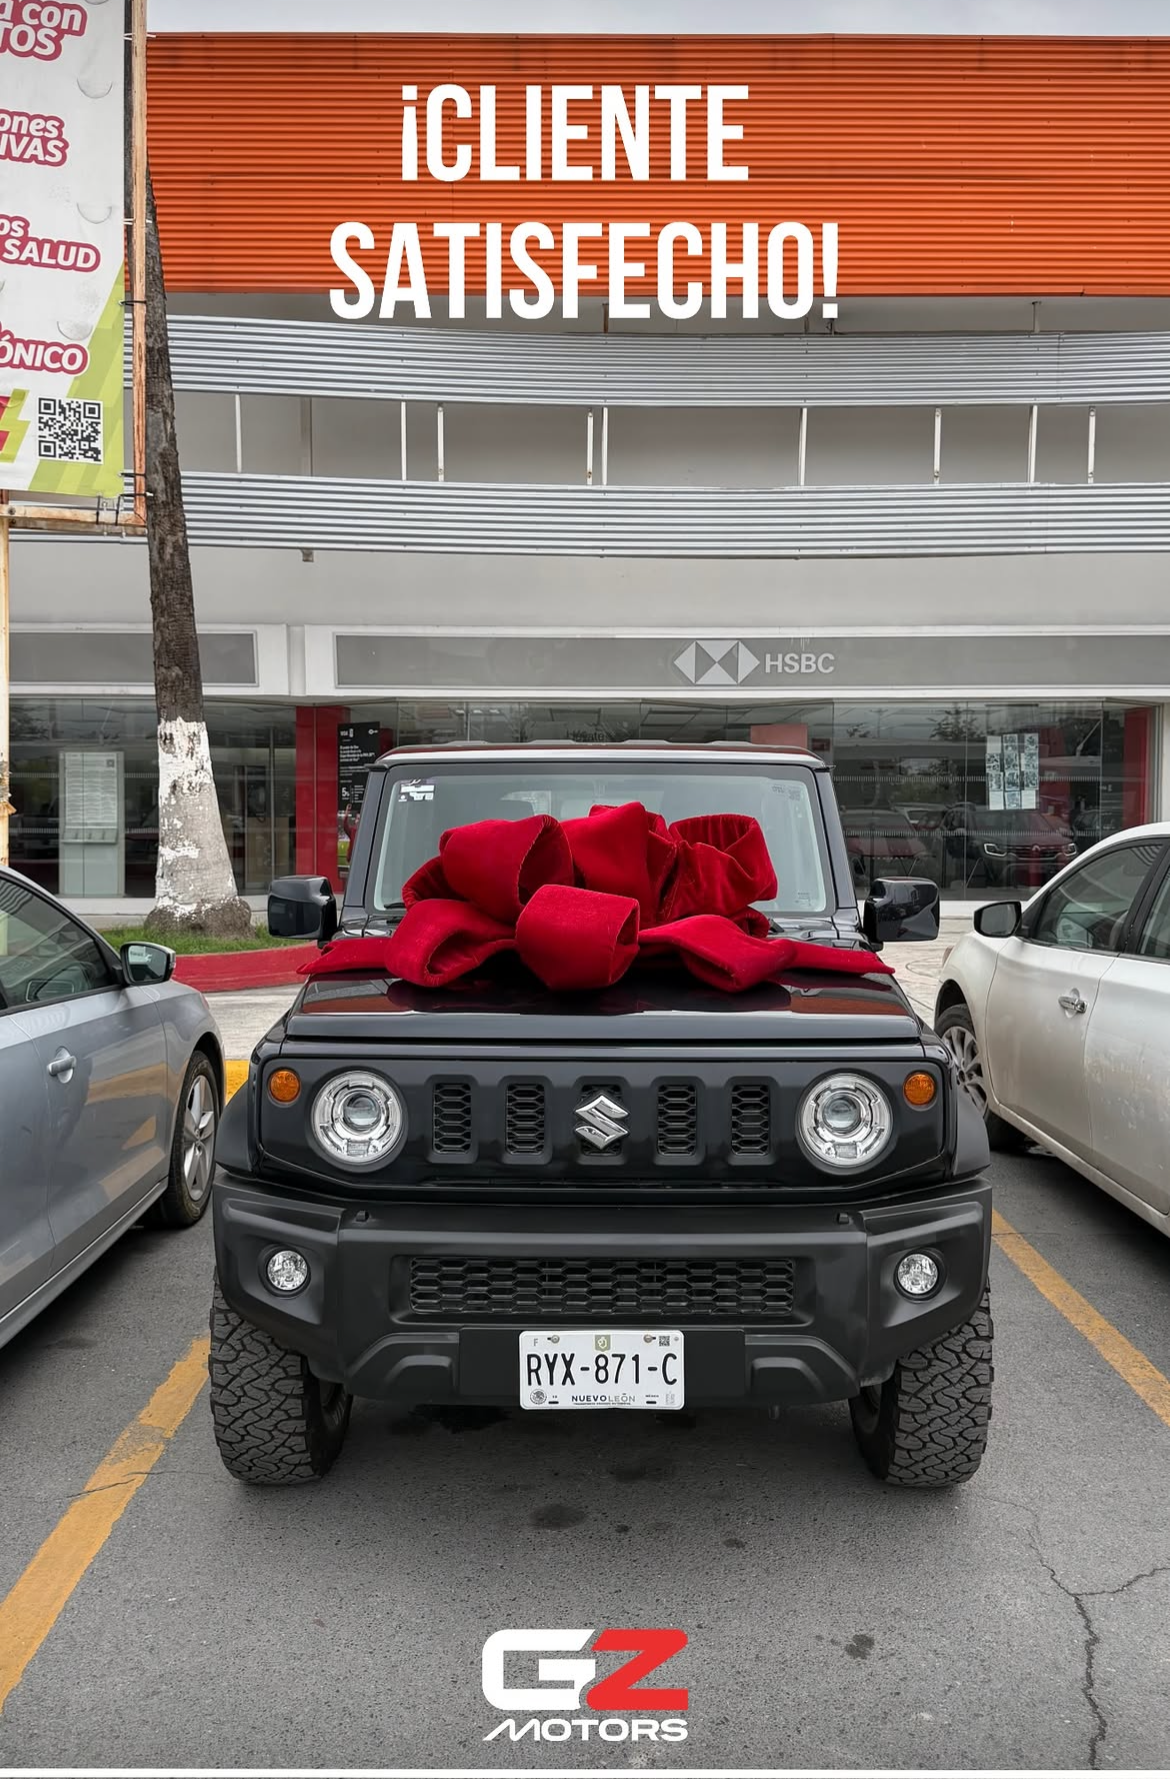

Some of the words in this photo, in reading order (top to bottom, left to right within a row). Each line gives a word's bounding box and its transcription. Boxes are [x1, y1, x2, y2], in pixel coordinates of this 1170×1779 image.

[22, 3, 82, 31] con
[0, 21, 58, 55] TOS
[0, 133, 65, 163] IVAS
[3, 239, 97, 269] SALUD
[0, 333, 83, 371] ÓNICO
[765, 653, 835, 674] HSBC
[526, 1353, 678, 1386] RYX-871-C
